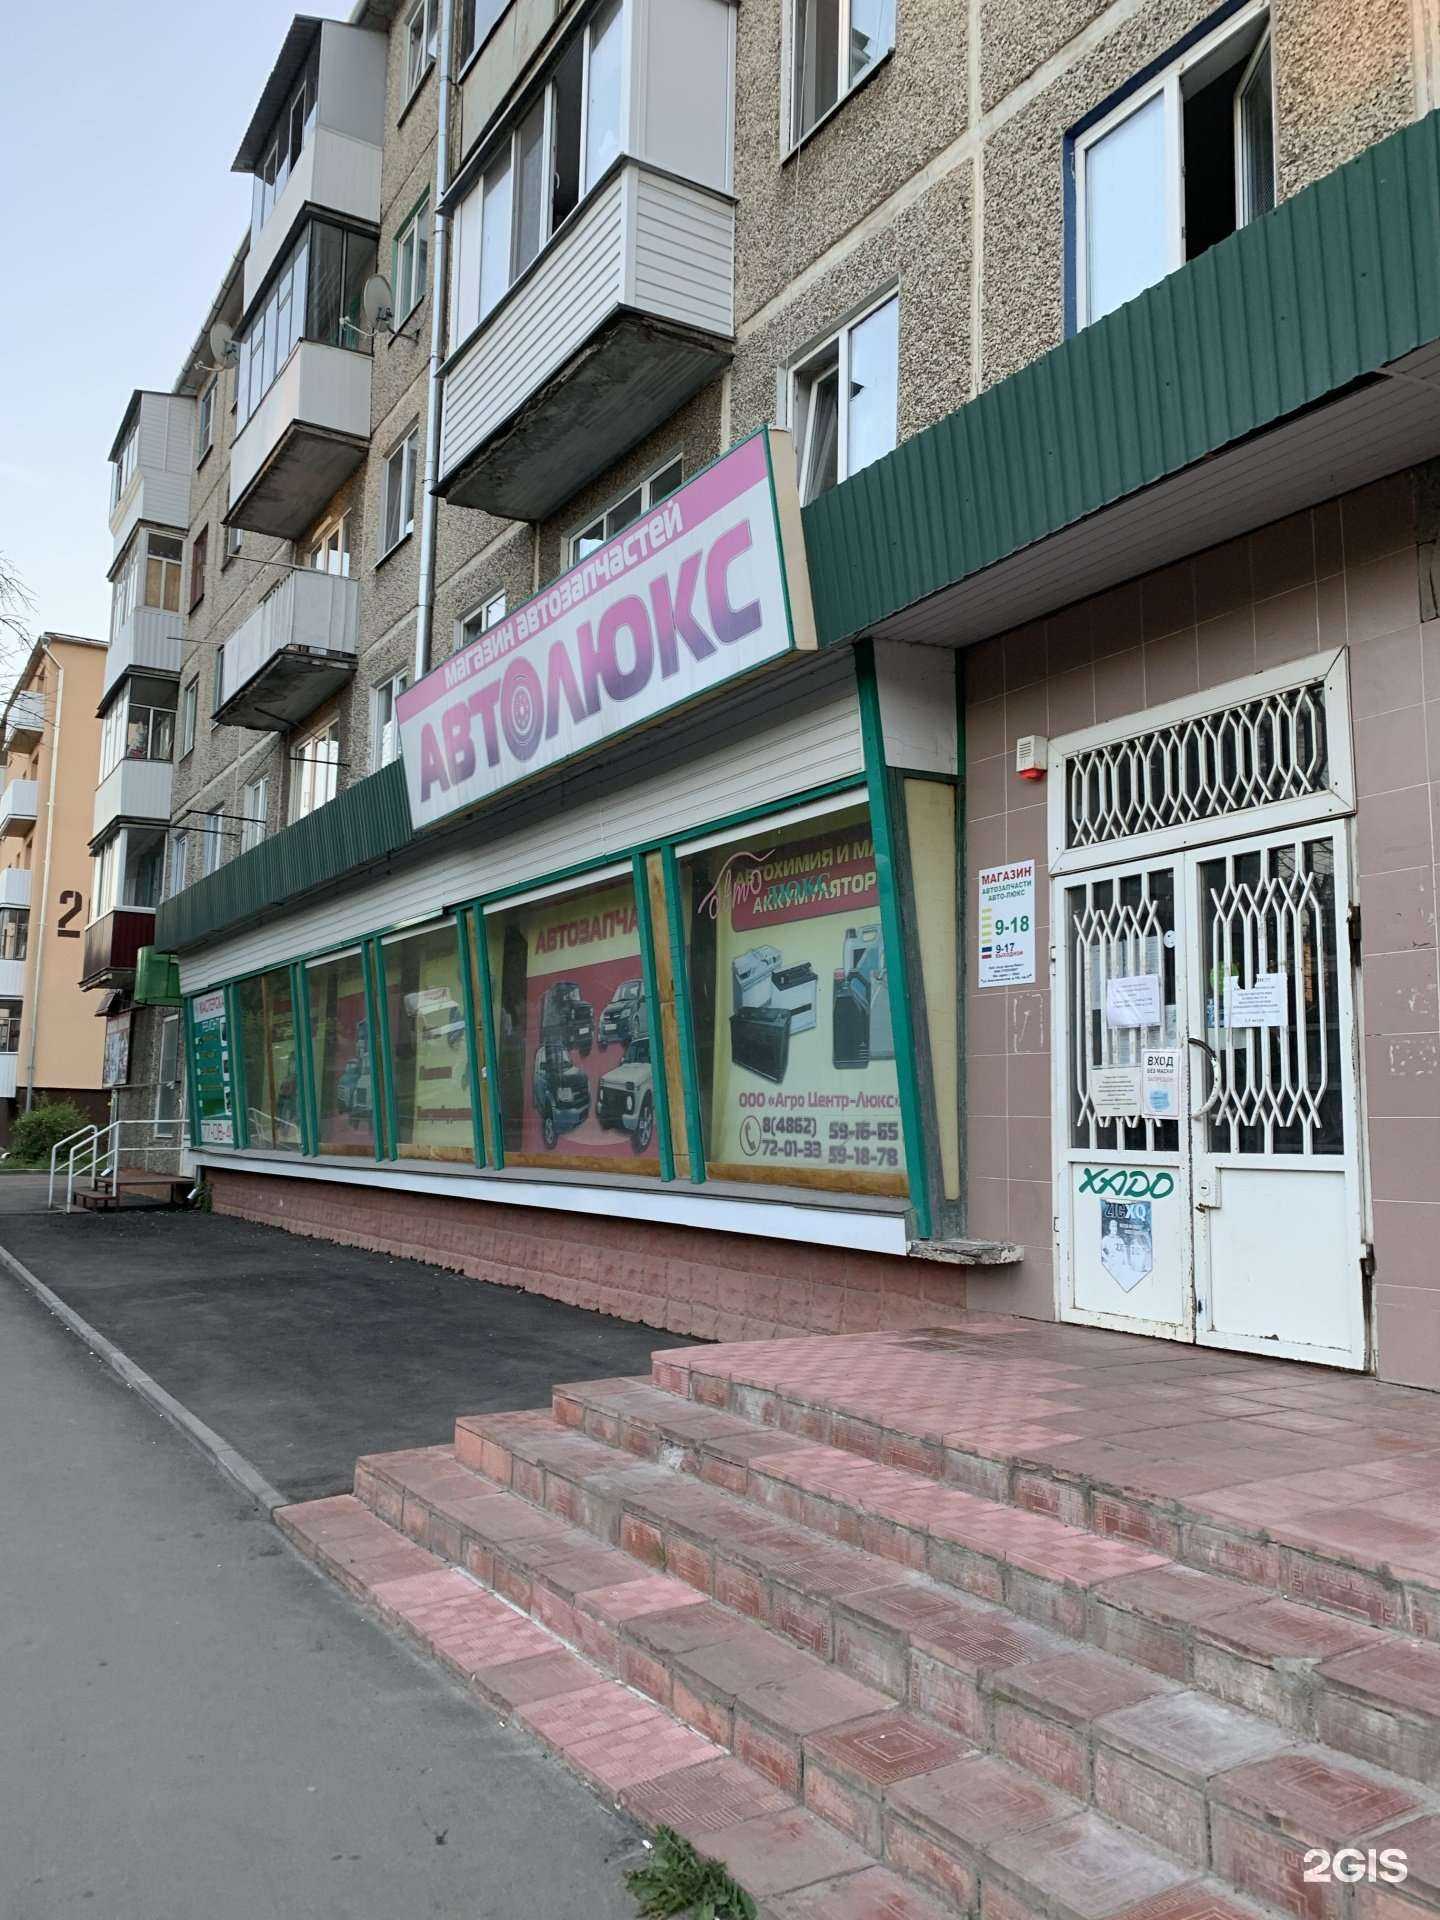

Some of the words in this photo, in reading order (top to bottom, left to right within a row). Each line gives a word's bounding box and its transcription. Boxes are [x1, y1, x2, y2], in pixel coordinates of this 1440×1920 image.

[445, 622, 514, 689] магазин
[517, 500, 684, 641] автозапчастей
[420, 518, 762, 803] АВТОЛЮКС
[837, 844, 850, 864] И
[981, 867, 1032, 885] МАГАЗИН
[982, 880, 1032, 895] АВТОЗАПЧАСТИ
[988, 890, 1026, 901] АВТО-ЛЮКС
[57, 890, 83, 938] 2
[995, 915, 1029, 936] 9-18
[995, 943, 1015, 953] 9-17
[1147, 1056, 1174, 1067] ВХОД
[739, 1092, 766, 1108] ООО
[768, 1092, 805, 1111] «Агро
[762, 1116, 817, 1138] 8(4862)
[762, 1140, 822, 1158] 72-01-33
[828, 1145, 899, 1166] 59-18-78
[1079, 1168, 1174, 1199] XADO
